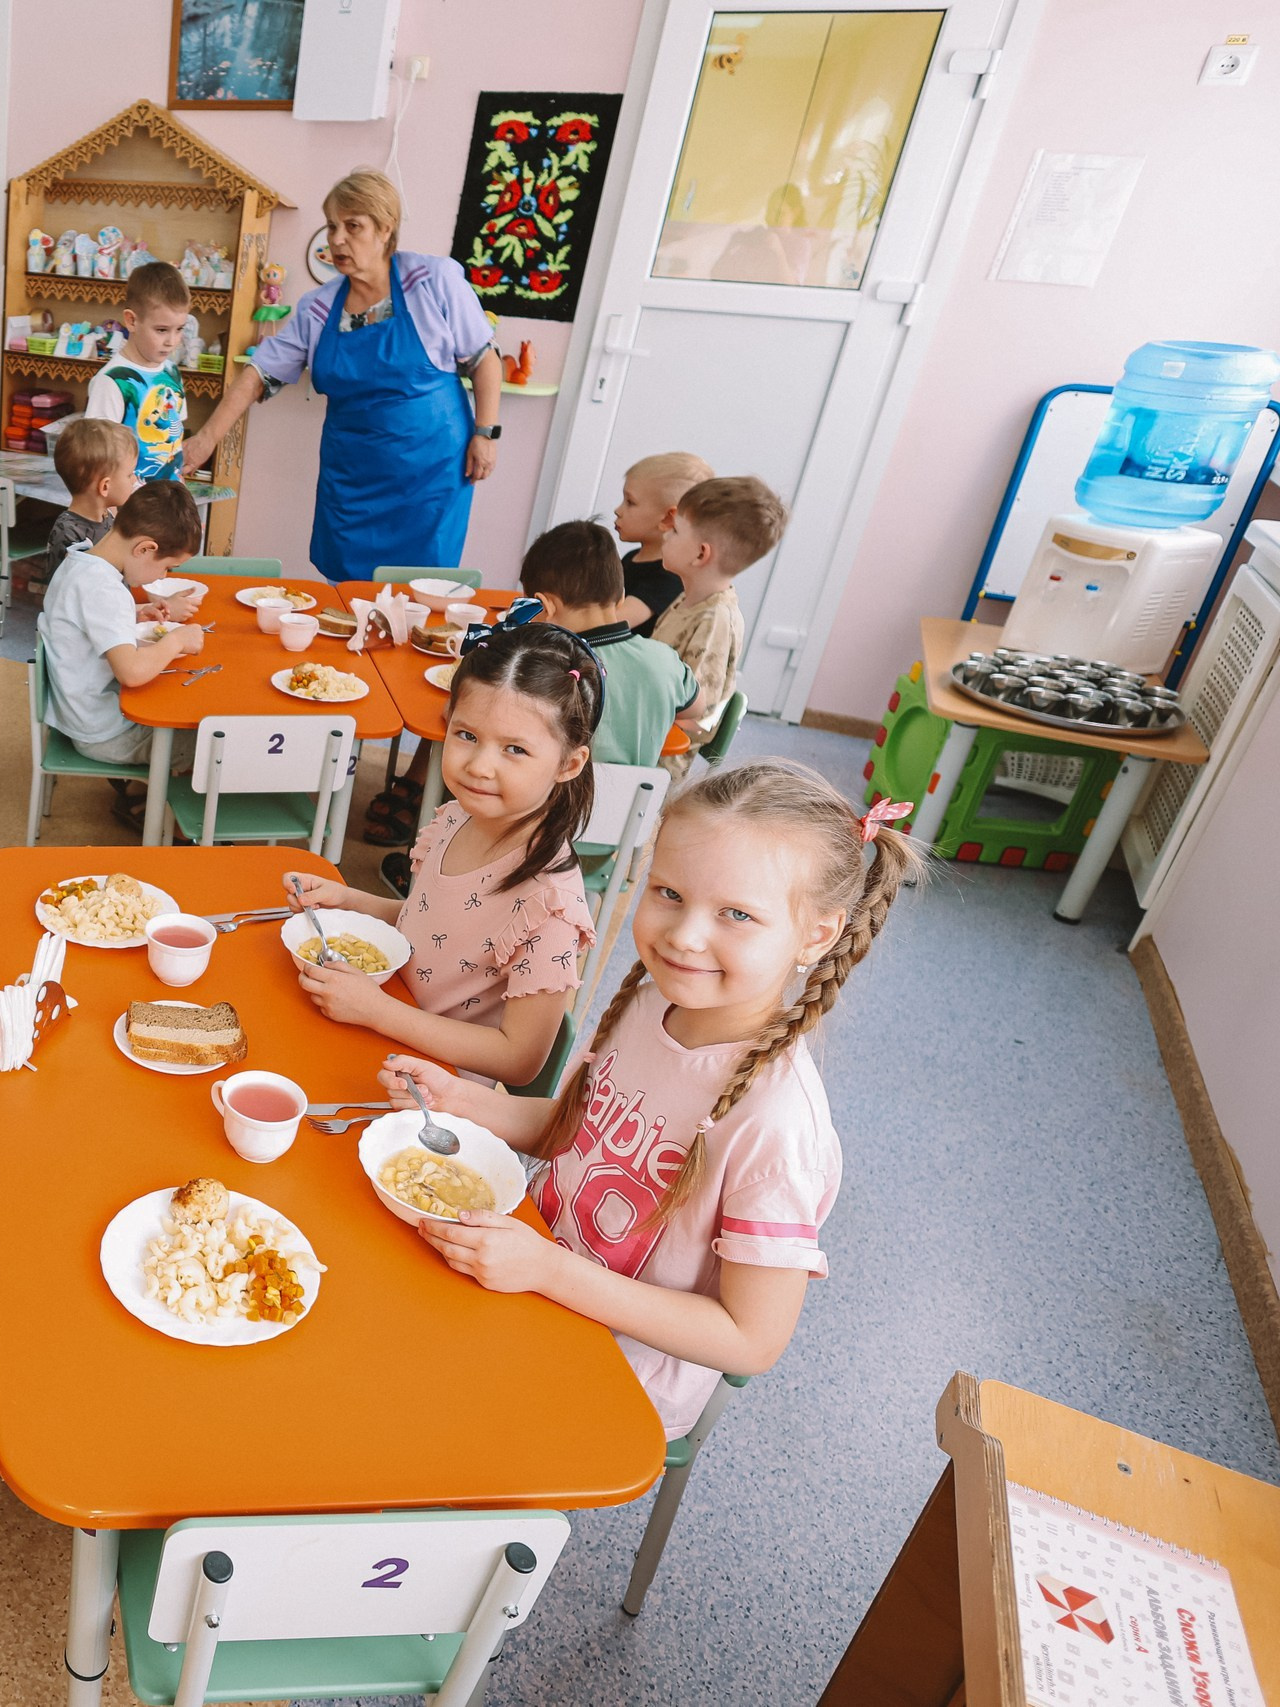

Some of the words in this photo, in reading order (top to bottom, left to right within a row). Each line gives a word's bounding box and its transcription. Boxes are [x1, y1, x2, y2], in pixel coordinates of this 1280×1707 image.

[268, 734, 285, 754] 2
[346, 756, 357, 776] 2
[361, 1558, 409, 1588] 2
[1146, 1586, 1169, 1642] АЛЬБОМ
[1129, 1616, 1142, 1642] серия
[1176, 1608, 1202, 1666] Сложи
